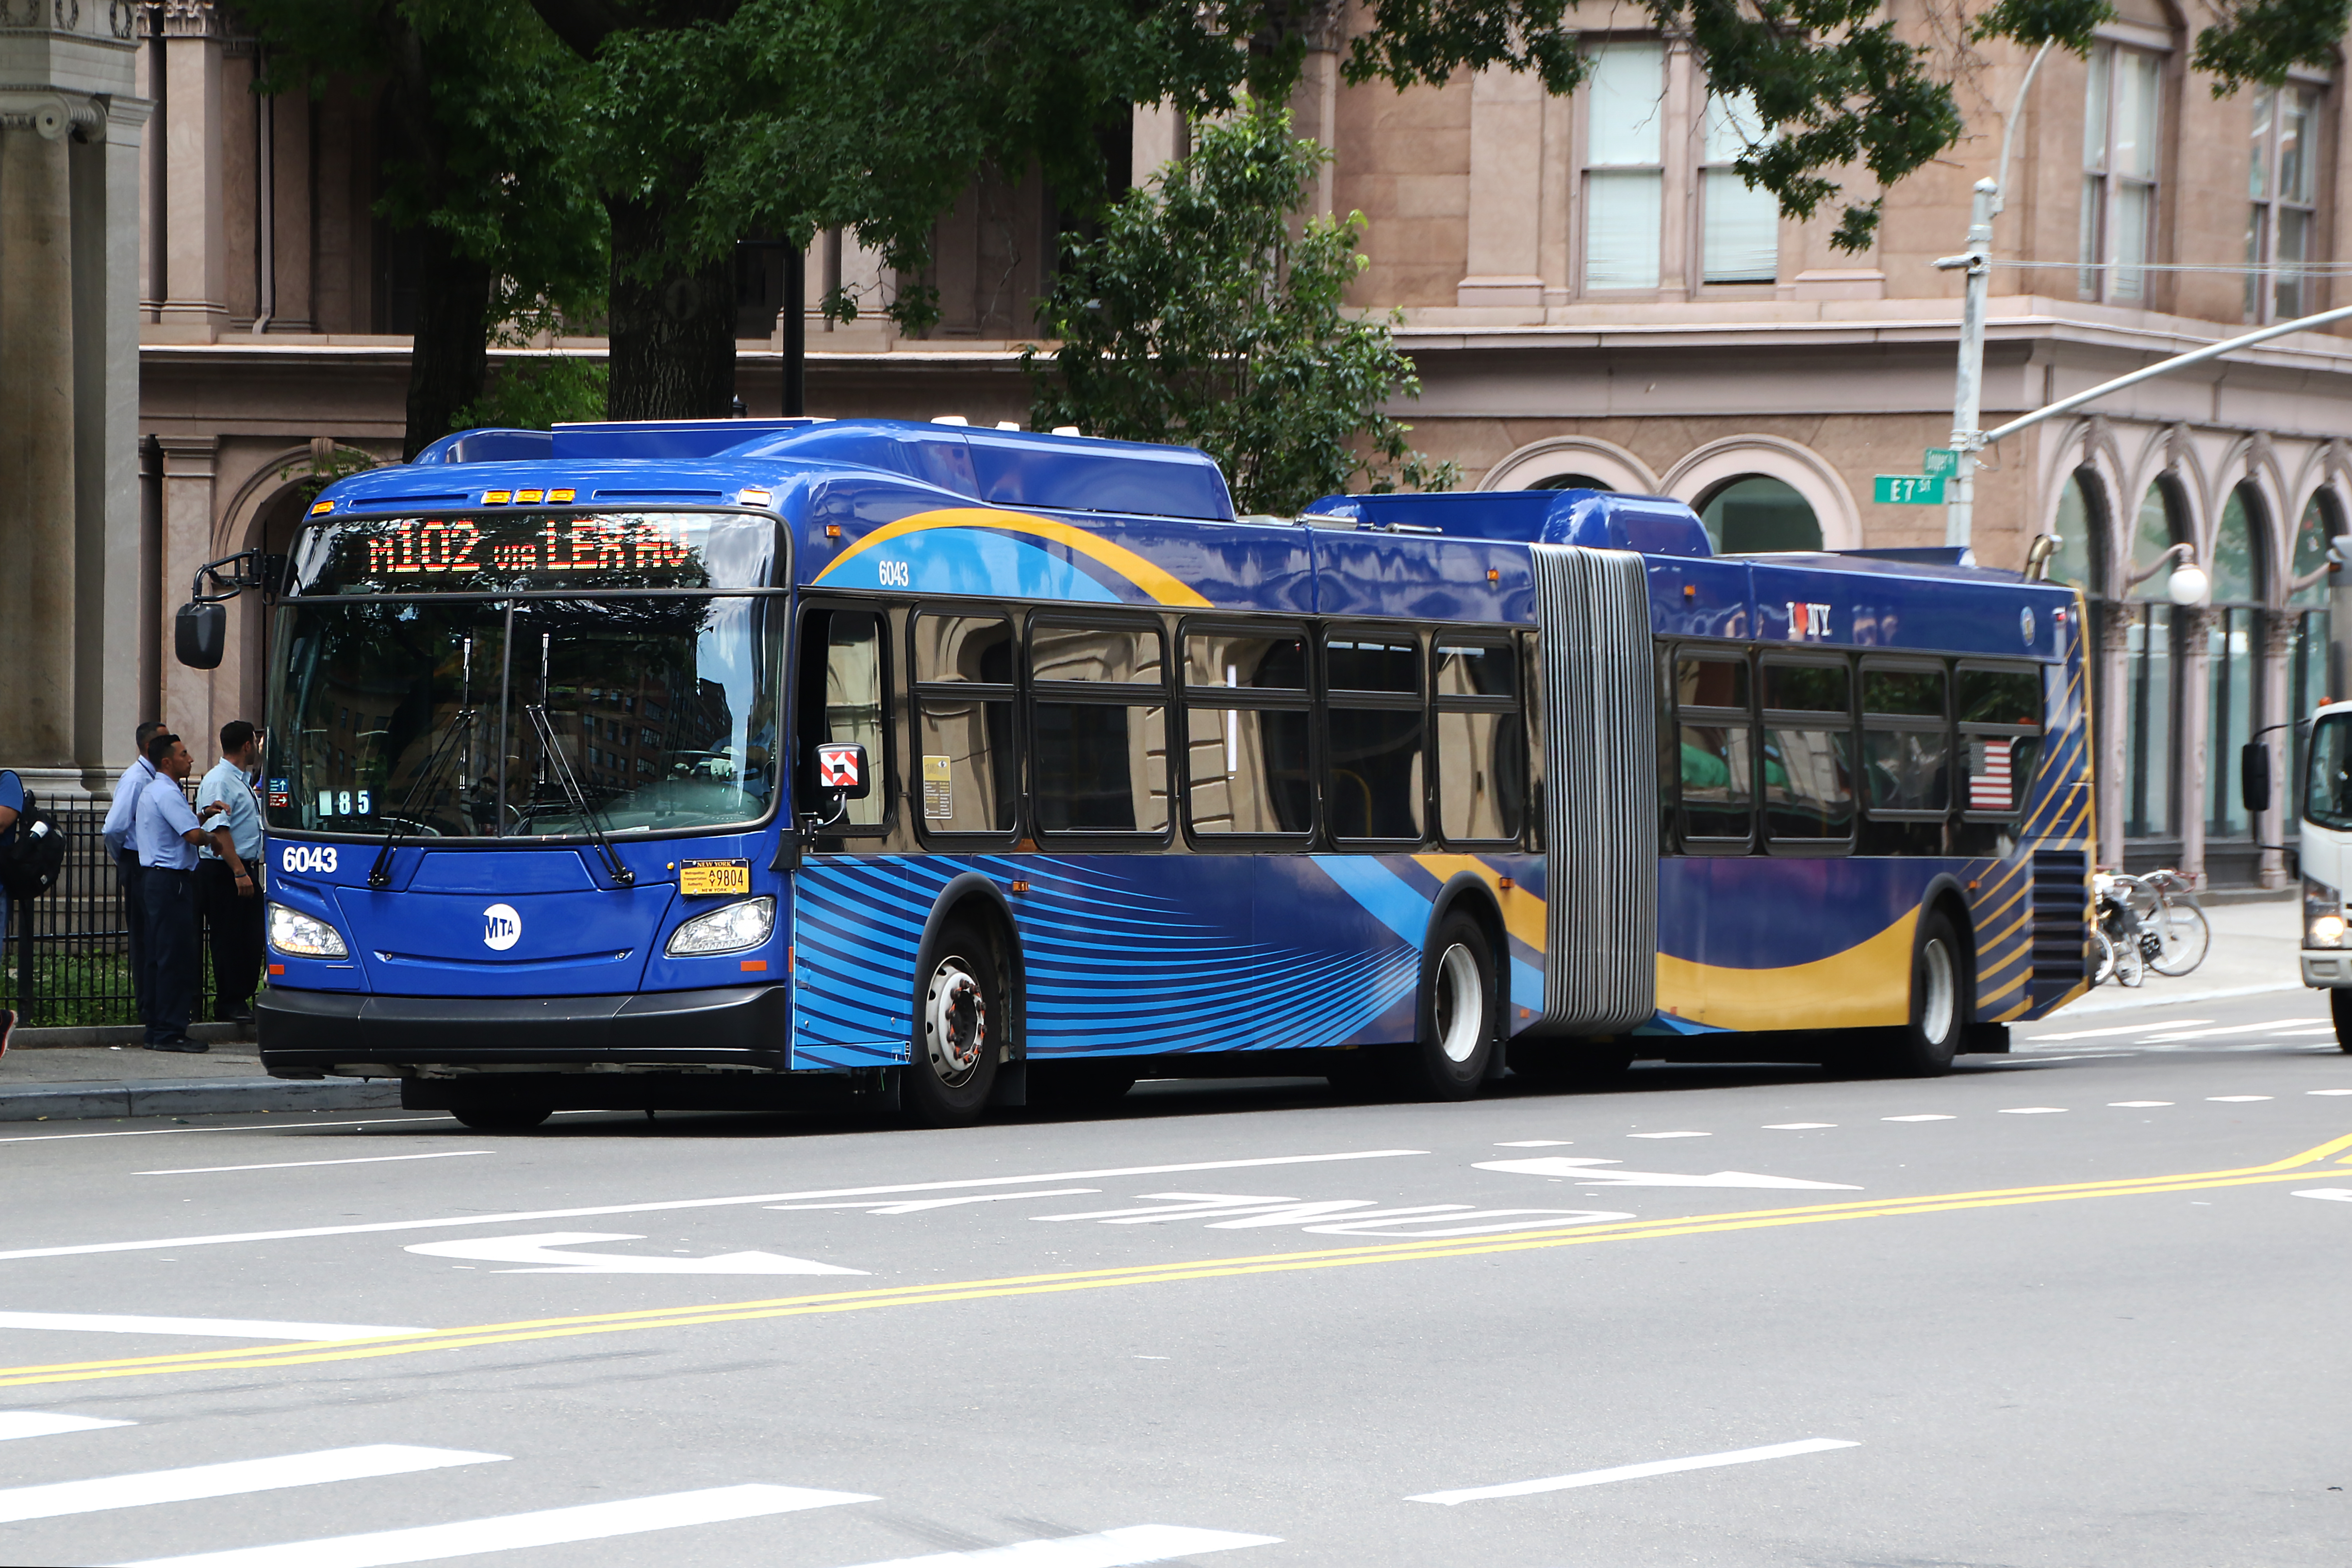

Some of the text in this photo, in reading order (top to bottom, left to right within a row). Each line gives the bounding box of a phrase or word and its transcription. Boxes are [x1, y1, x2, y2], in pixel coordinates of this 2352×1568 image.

[1889, 479, 1901, 502] E
[1903, 479, 1915, 502] 7
[369, 519, 689, 573] M102 VIA LEX AV
[879, 560, 909, 587] 6043
[283, 847, 337, 873] 6043
[717, 869, 743, 886] 9804
[485, 915, 513, 940] MTA
